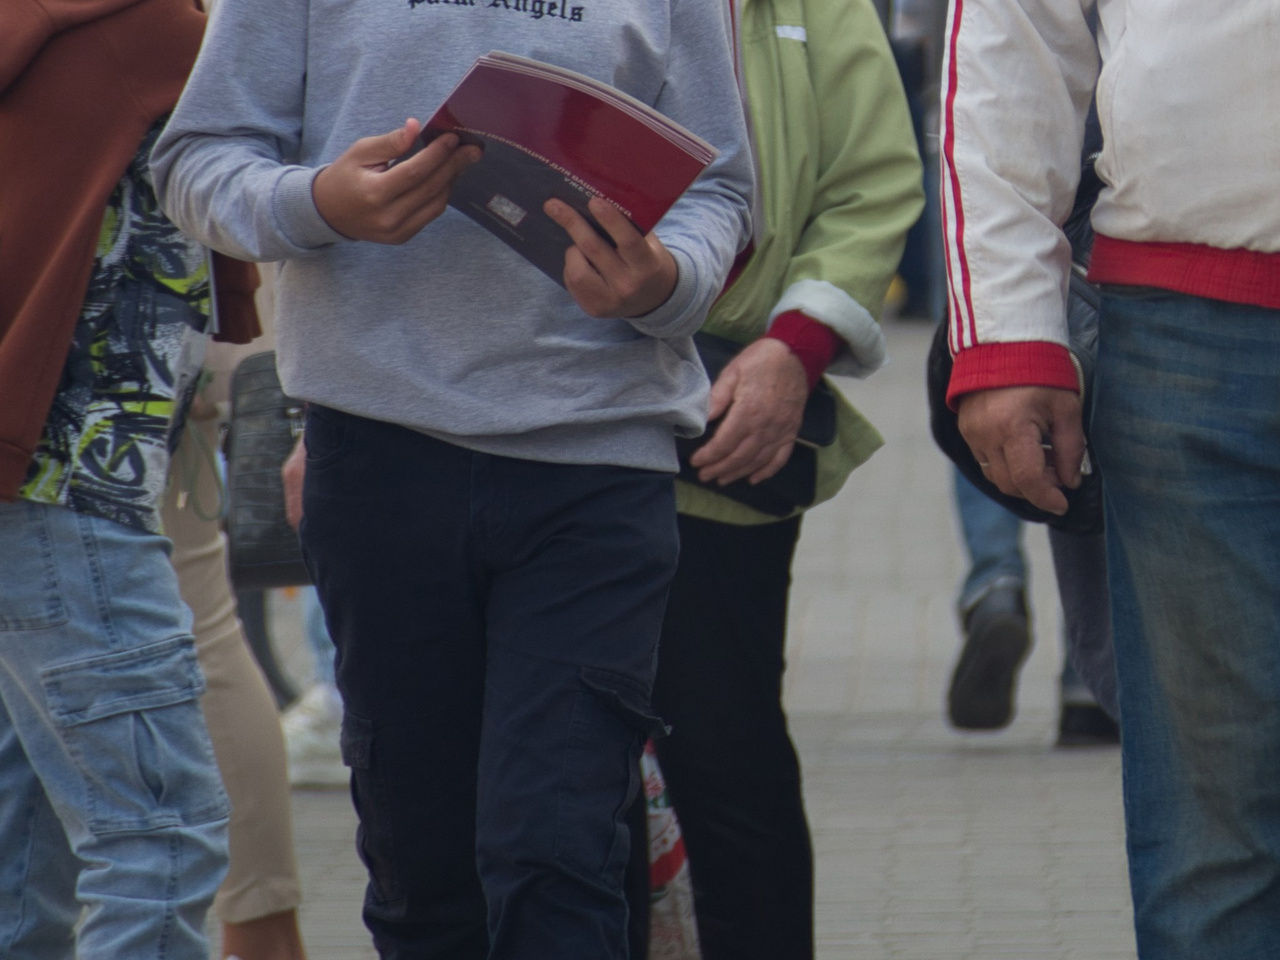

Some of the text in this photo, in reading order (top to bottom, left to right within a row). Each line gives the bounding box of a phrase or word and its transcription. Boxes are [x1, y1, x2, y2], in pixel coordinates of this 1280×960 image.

[549, 162, 572, 176] ДЛЯ
[571, 174, 606, 198] ВАШИХ
[563, 176, 586, 193] УЖЕ
